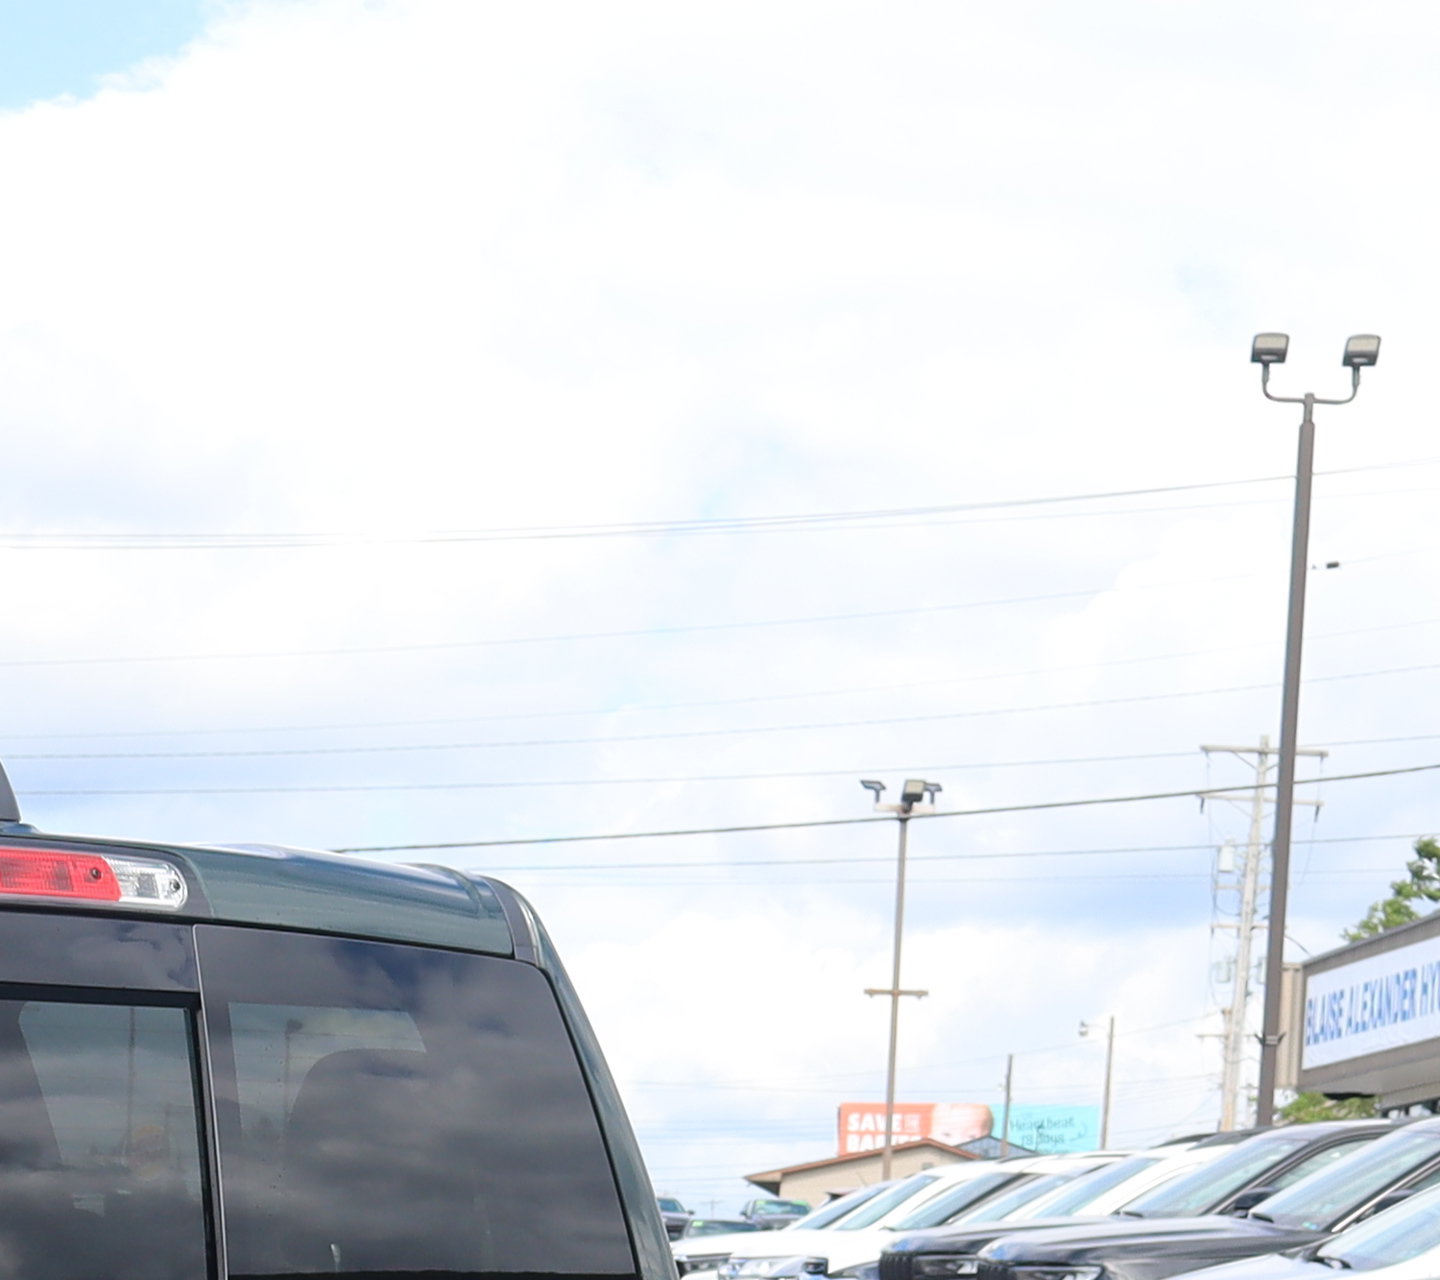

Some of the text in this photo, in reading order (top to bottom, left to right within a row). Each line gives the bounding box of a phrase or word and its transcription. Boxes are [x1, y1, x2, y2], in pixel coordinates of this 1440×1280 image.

[1305, 988, 1344, 1046] BLAISE
[1345, 967, 1418, 1036] ALEXANDER
[847, 1112, 902, 1132] SAVE
